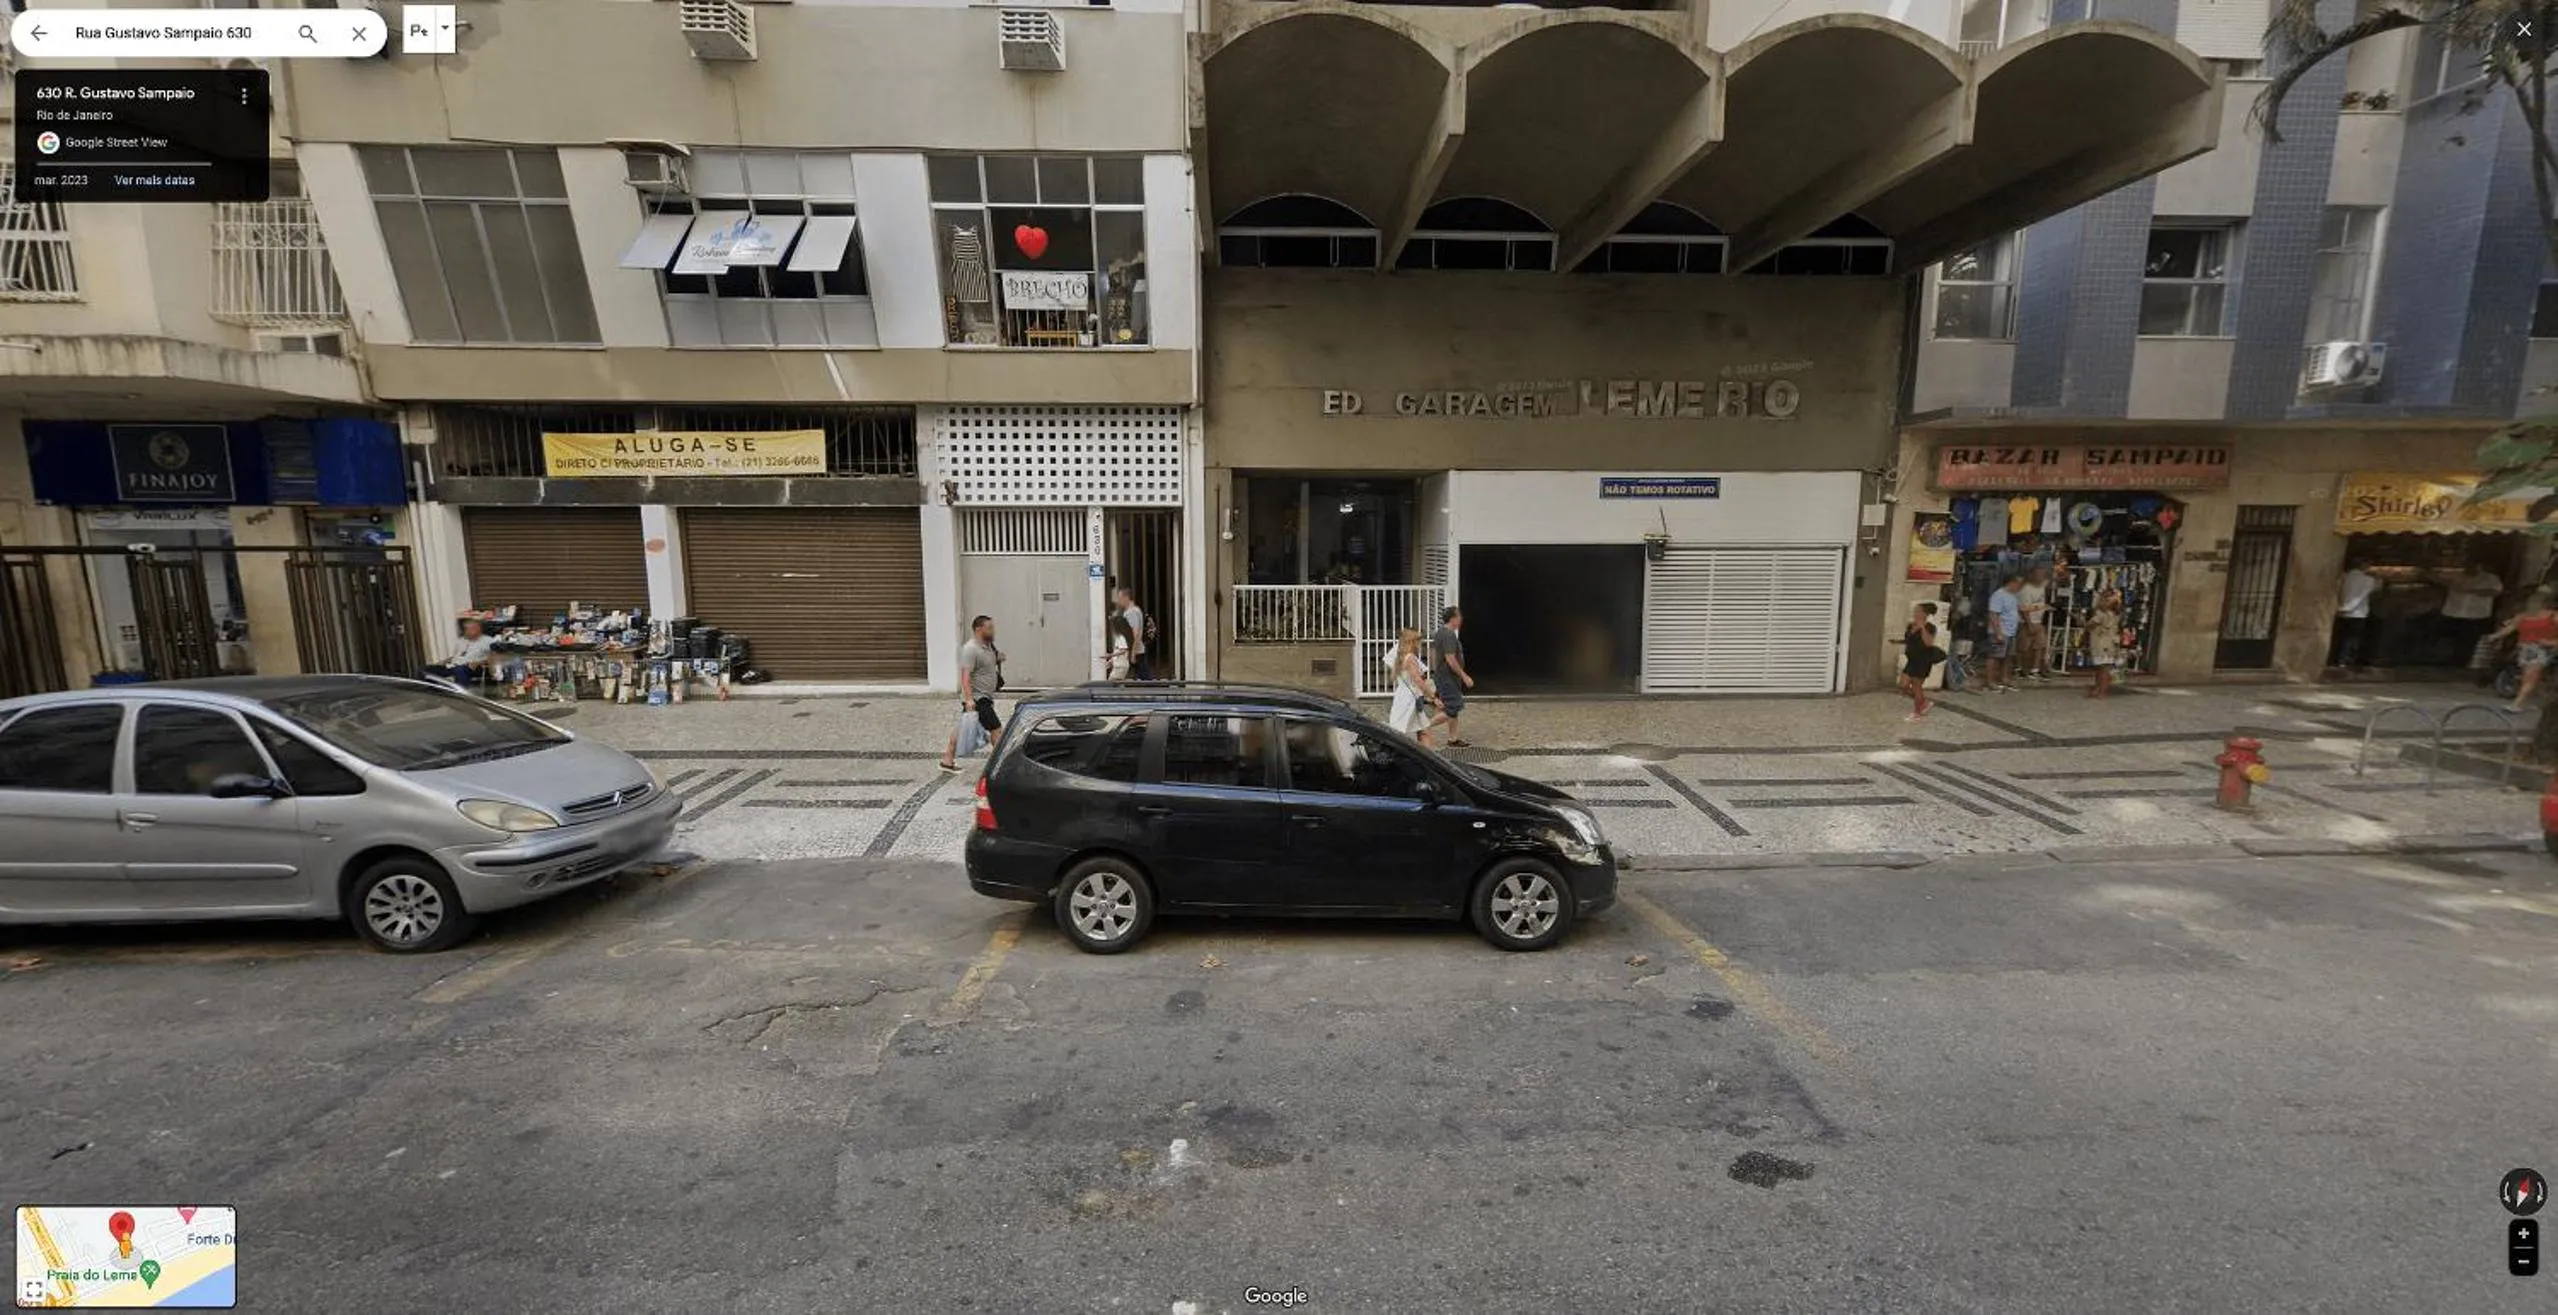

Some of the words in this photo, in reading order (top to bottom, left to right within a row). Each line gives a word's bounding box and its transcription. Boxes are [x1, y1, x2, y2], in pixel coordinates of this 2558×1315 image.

[1323, 389, 1363, 416] ED
[555, 458, 598, 470] DIRETO
[1949, 448, 2060, 466] BAZAR
[2086, 448, 2228, 466] SAMPAIO
[127, 472, 219, 490] FINAJOY
[1667, 484, 1716, 495] ROTATIVO
[2354, 495, 2452, 520] Shirley
